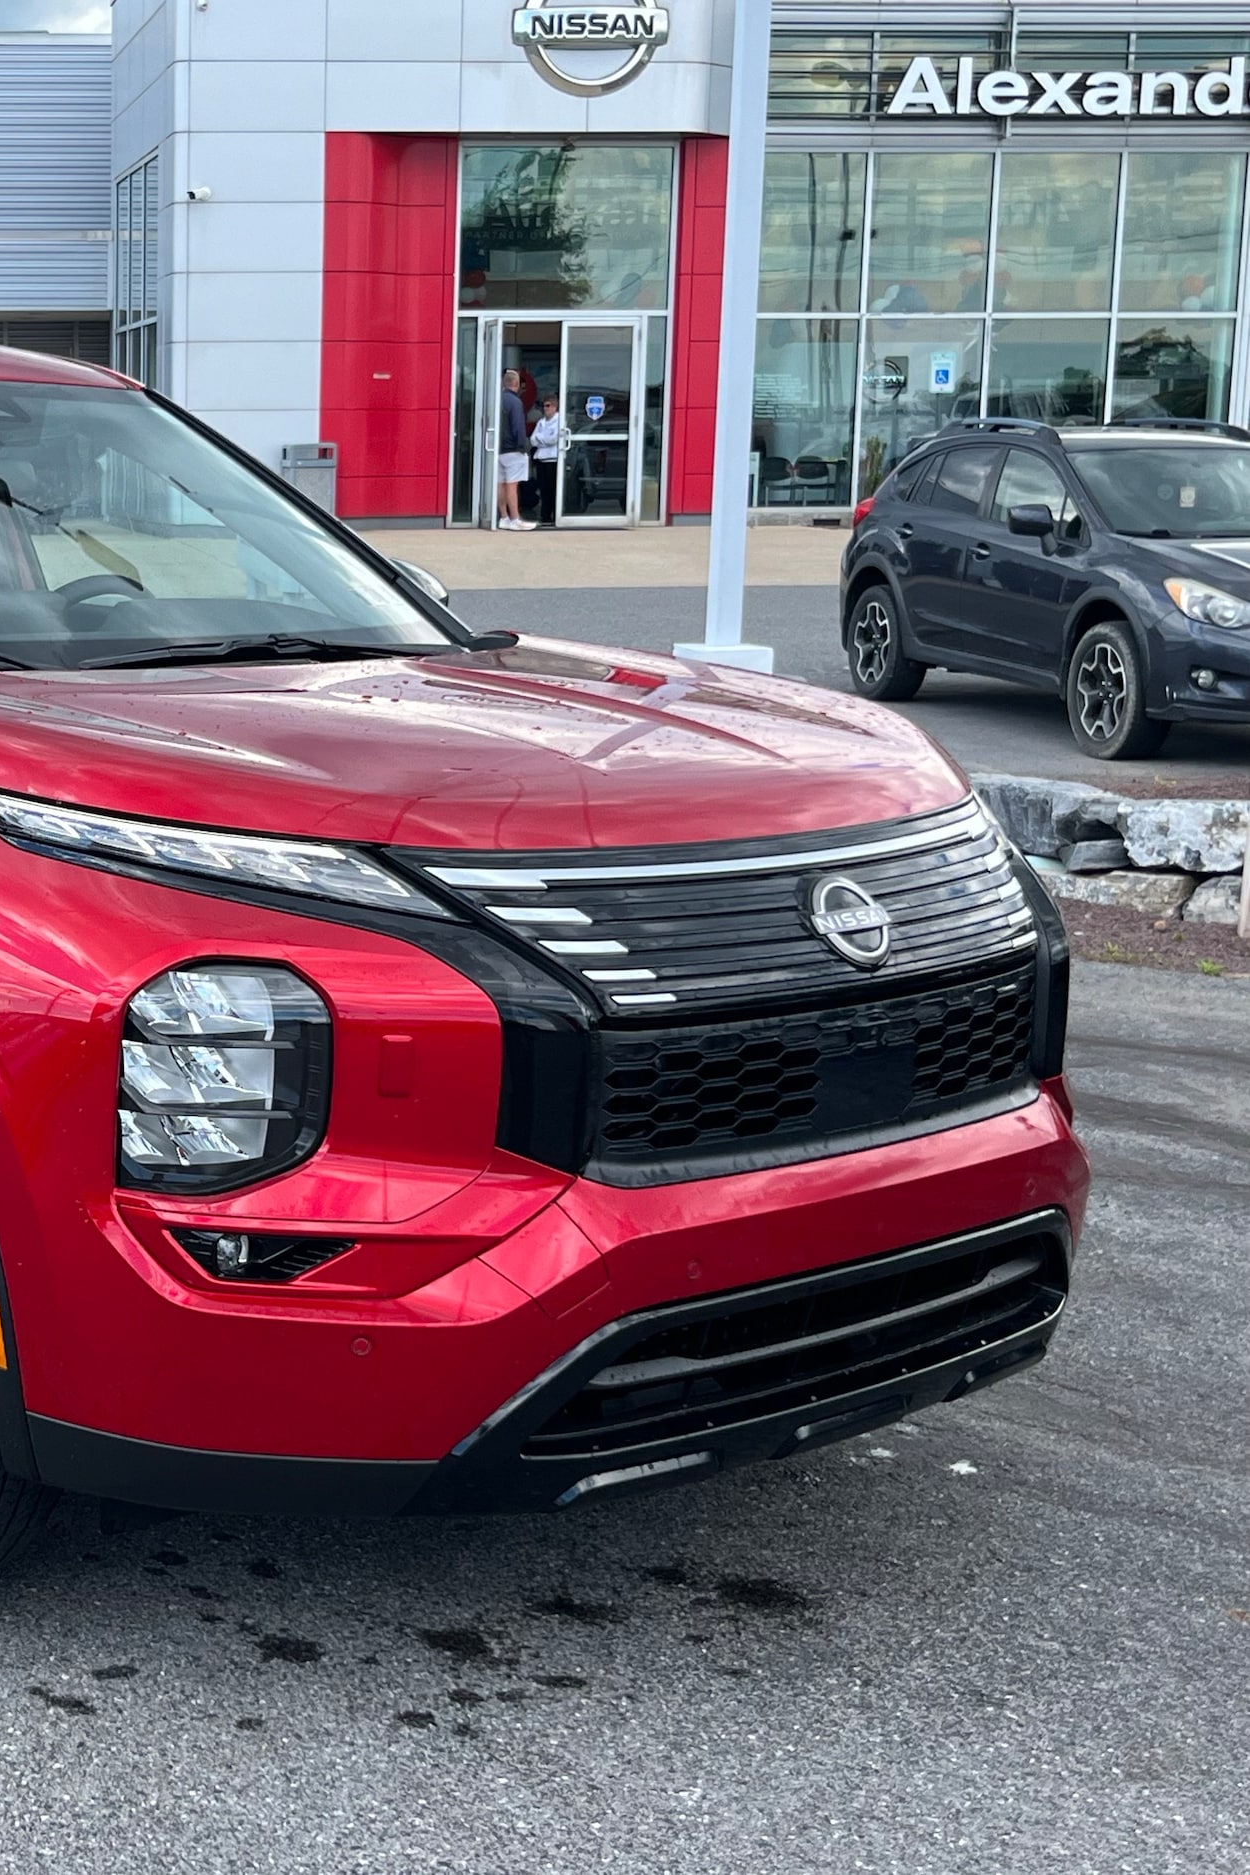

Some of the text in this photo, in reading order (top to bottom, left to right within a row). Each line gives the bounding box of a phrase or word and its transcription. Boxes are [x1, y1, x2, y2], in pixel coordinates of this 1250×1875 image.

[530, 13, 655, 38] NISSAN
[886, 56, 1250, 117] Alexand
[814, 908, 891, 932] NISSAN
